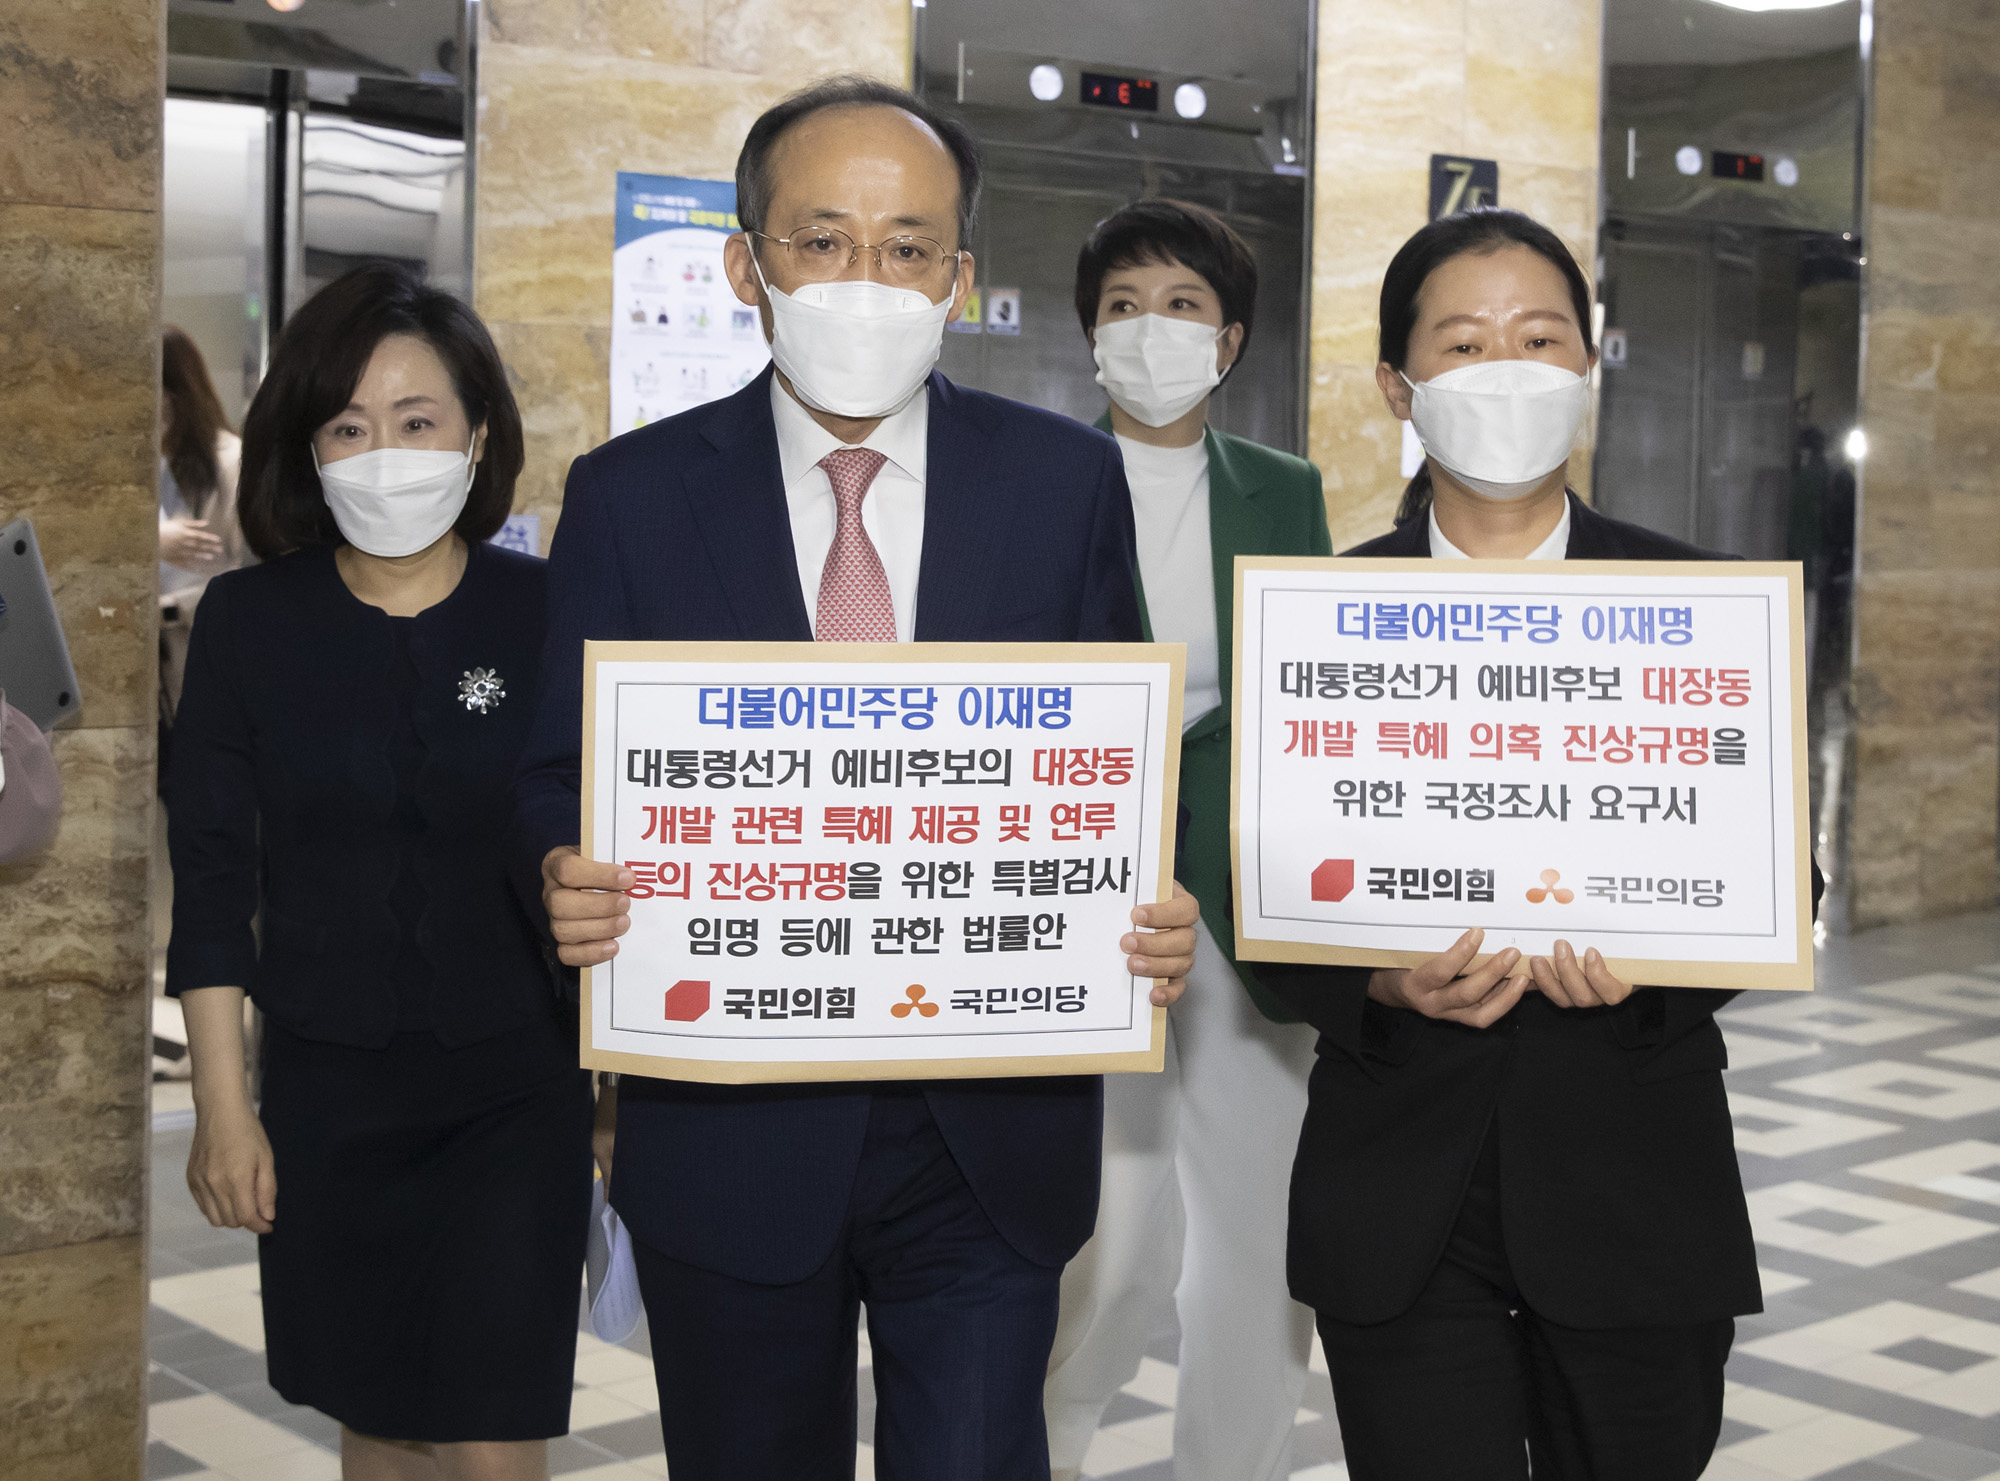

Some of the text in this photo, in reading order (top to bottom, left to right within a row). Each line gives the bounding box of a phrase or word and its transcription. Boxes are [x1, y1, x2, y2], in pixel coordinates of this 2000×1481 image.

[1338, 603, 1692, 645] 더불어민주당 이재명
[1281, 662, 1751, 706] 대통령선거 예비후보 대장동
[699, 687, 1071, 730] 더불어민주당 이재명
[1284, 720, 1746, 765] 개발 특혜 의혹 진상규명을
[627, 748, 1134, 789] 대통령선거 예비후보의 대장동
[1333, 780, 1696, 824] 위한 국정조사 요구서
[641, 803, 1115, 844] 개발 관련 특혜 제공 및 연루
[624, 857, 1131, 901] 등의 진상규명을 위한 특별검사
[1367, 868, 1494, 902] 국민의힘
[1584, 876, 1725, 908] 국민의당
[688, 913, 1067, 957] 임명 등에 관한 법률안
[724, 987, 855, 1019] 국민의힘
[950, 985, 1088, 1014] 국민의당
